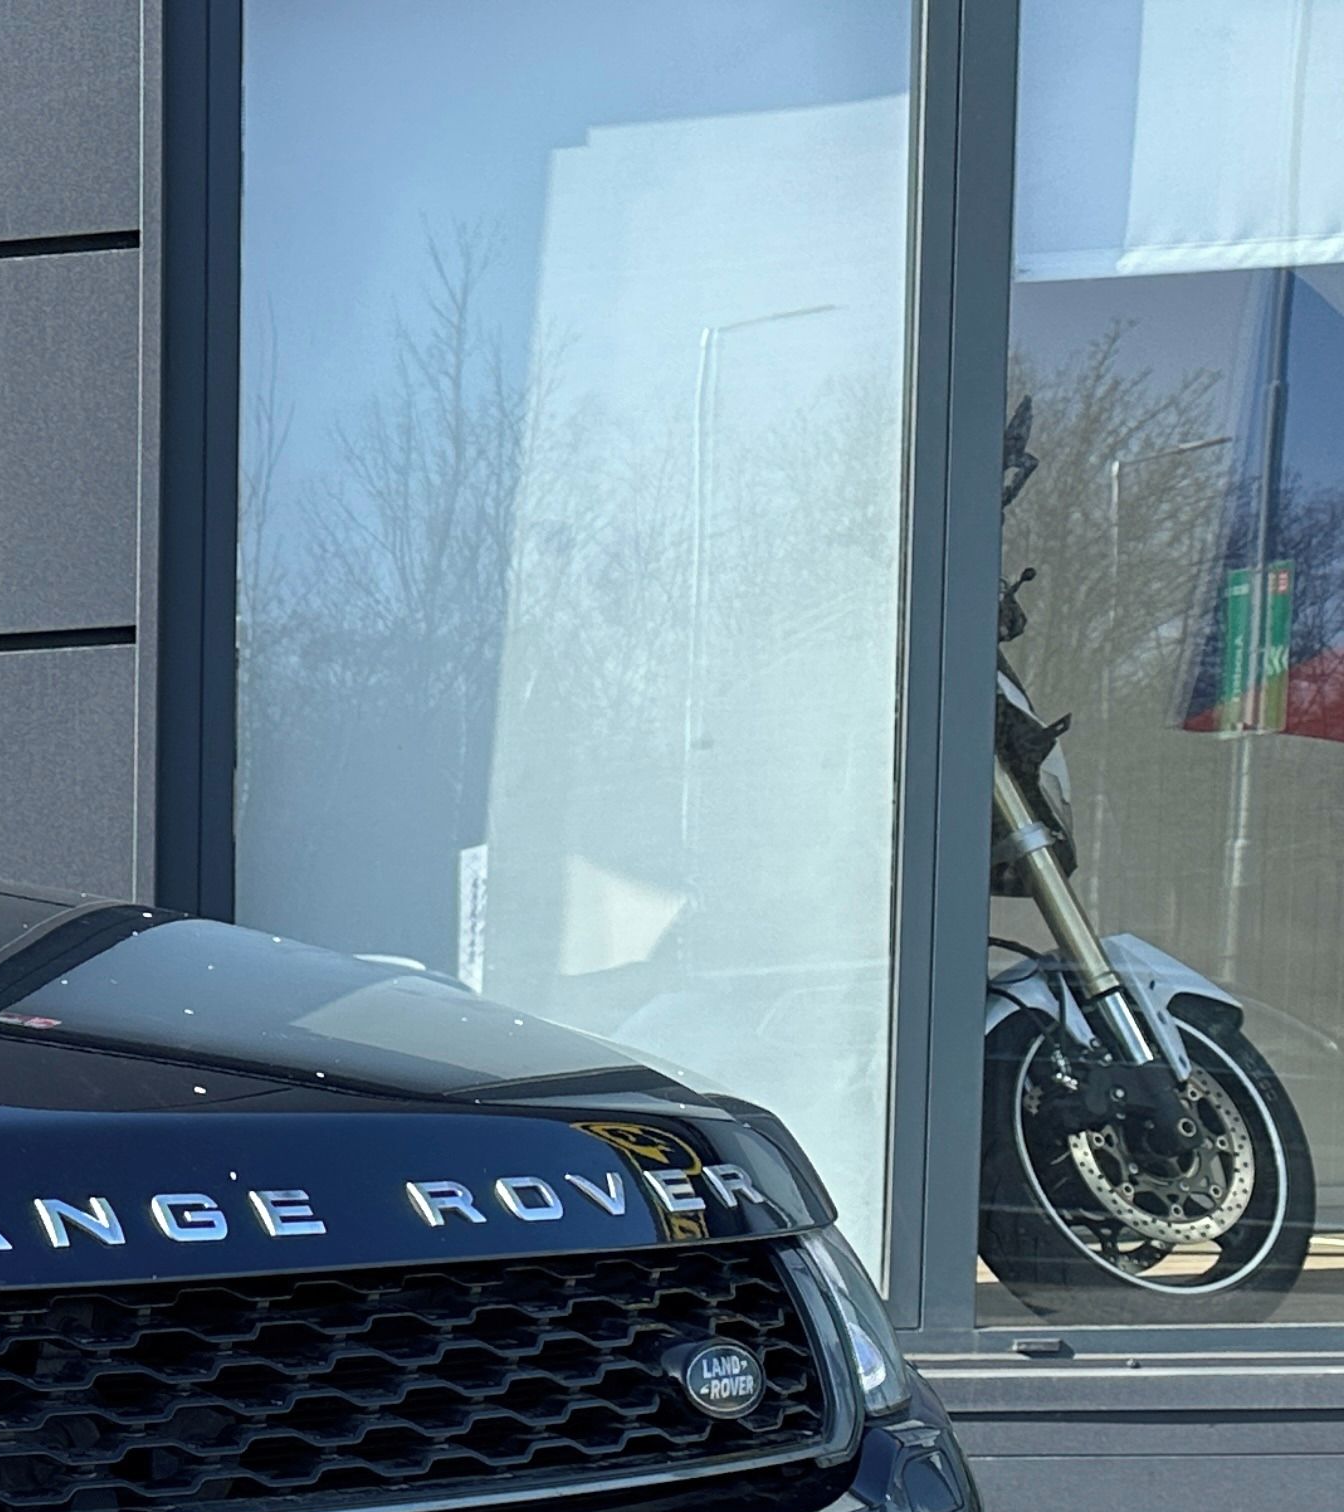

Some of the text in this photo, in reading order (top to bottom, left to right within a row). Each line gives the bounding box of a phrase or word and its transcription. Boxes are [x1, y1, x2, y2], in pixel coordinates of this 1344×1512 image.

[405, 1163, 766, 1228] ROVER
[701, 1354, 740, 1379] LAND
[709, 1375, 754, 1400] ROVER
